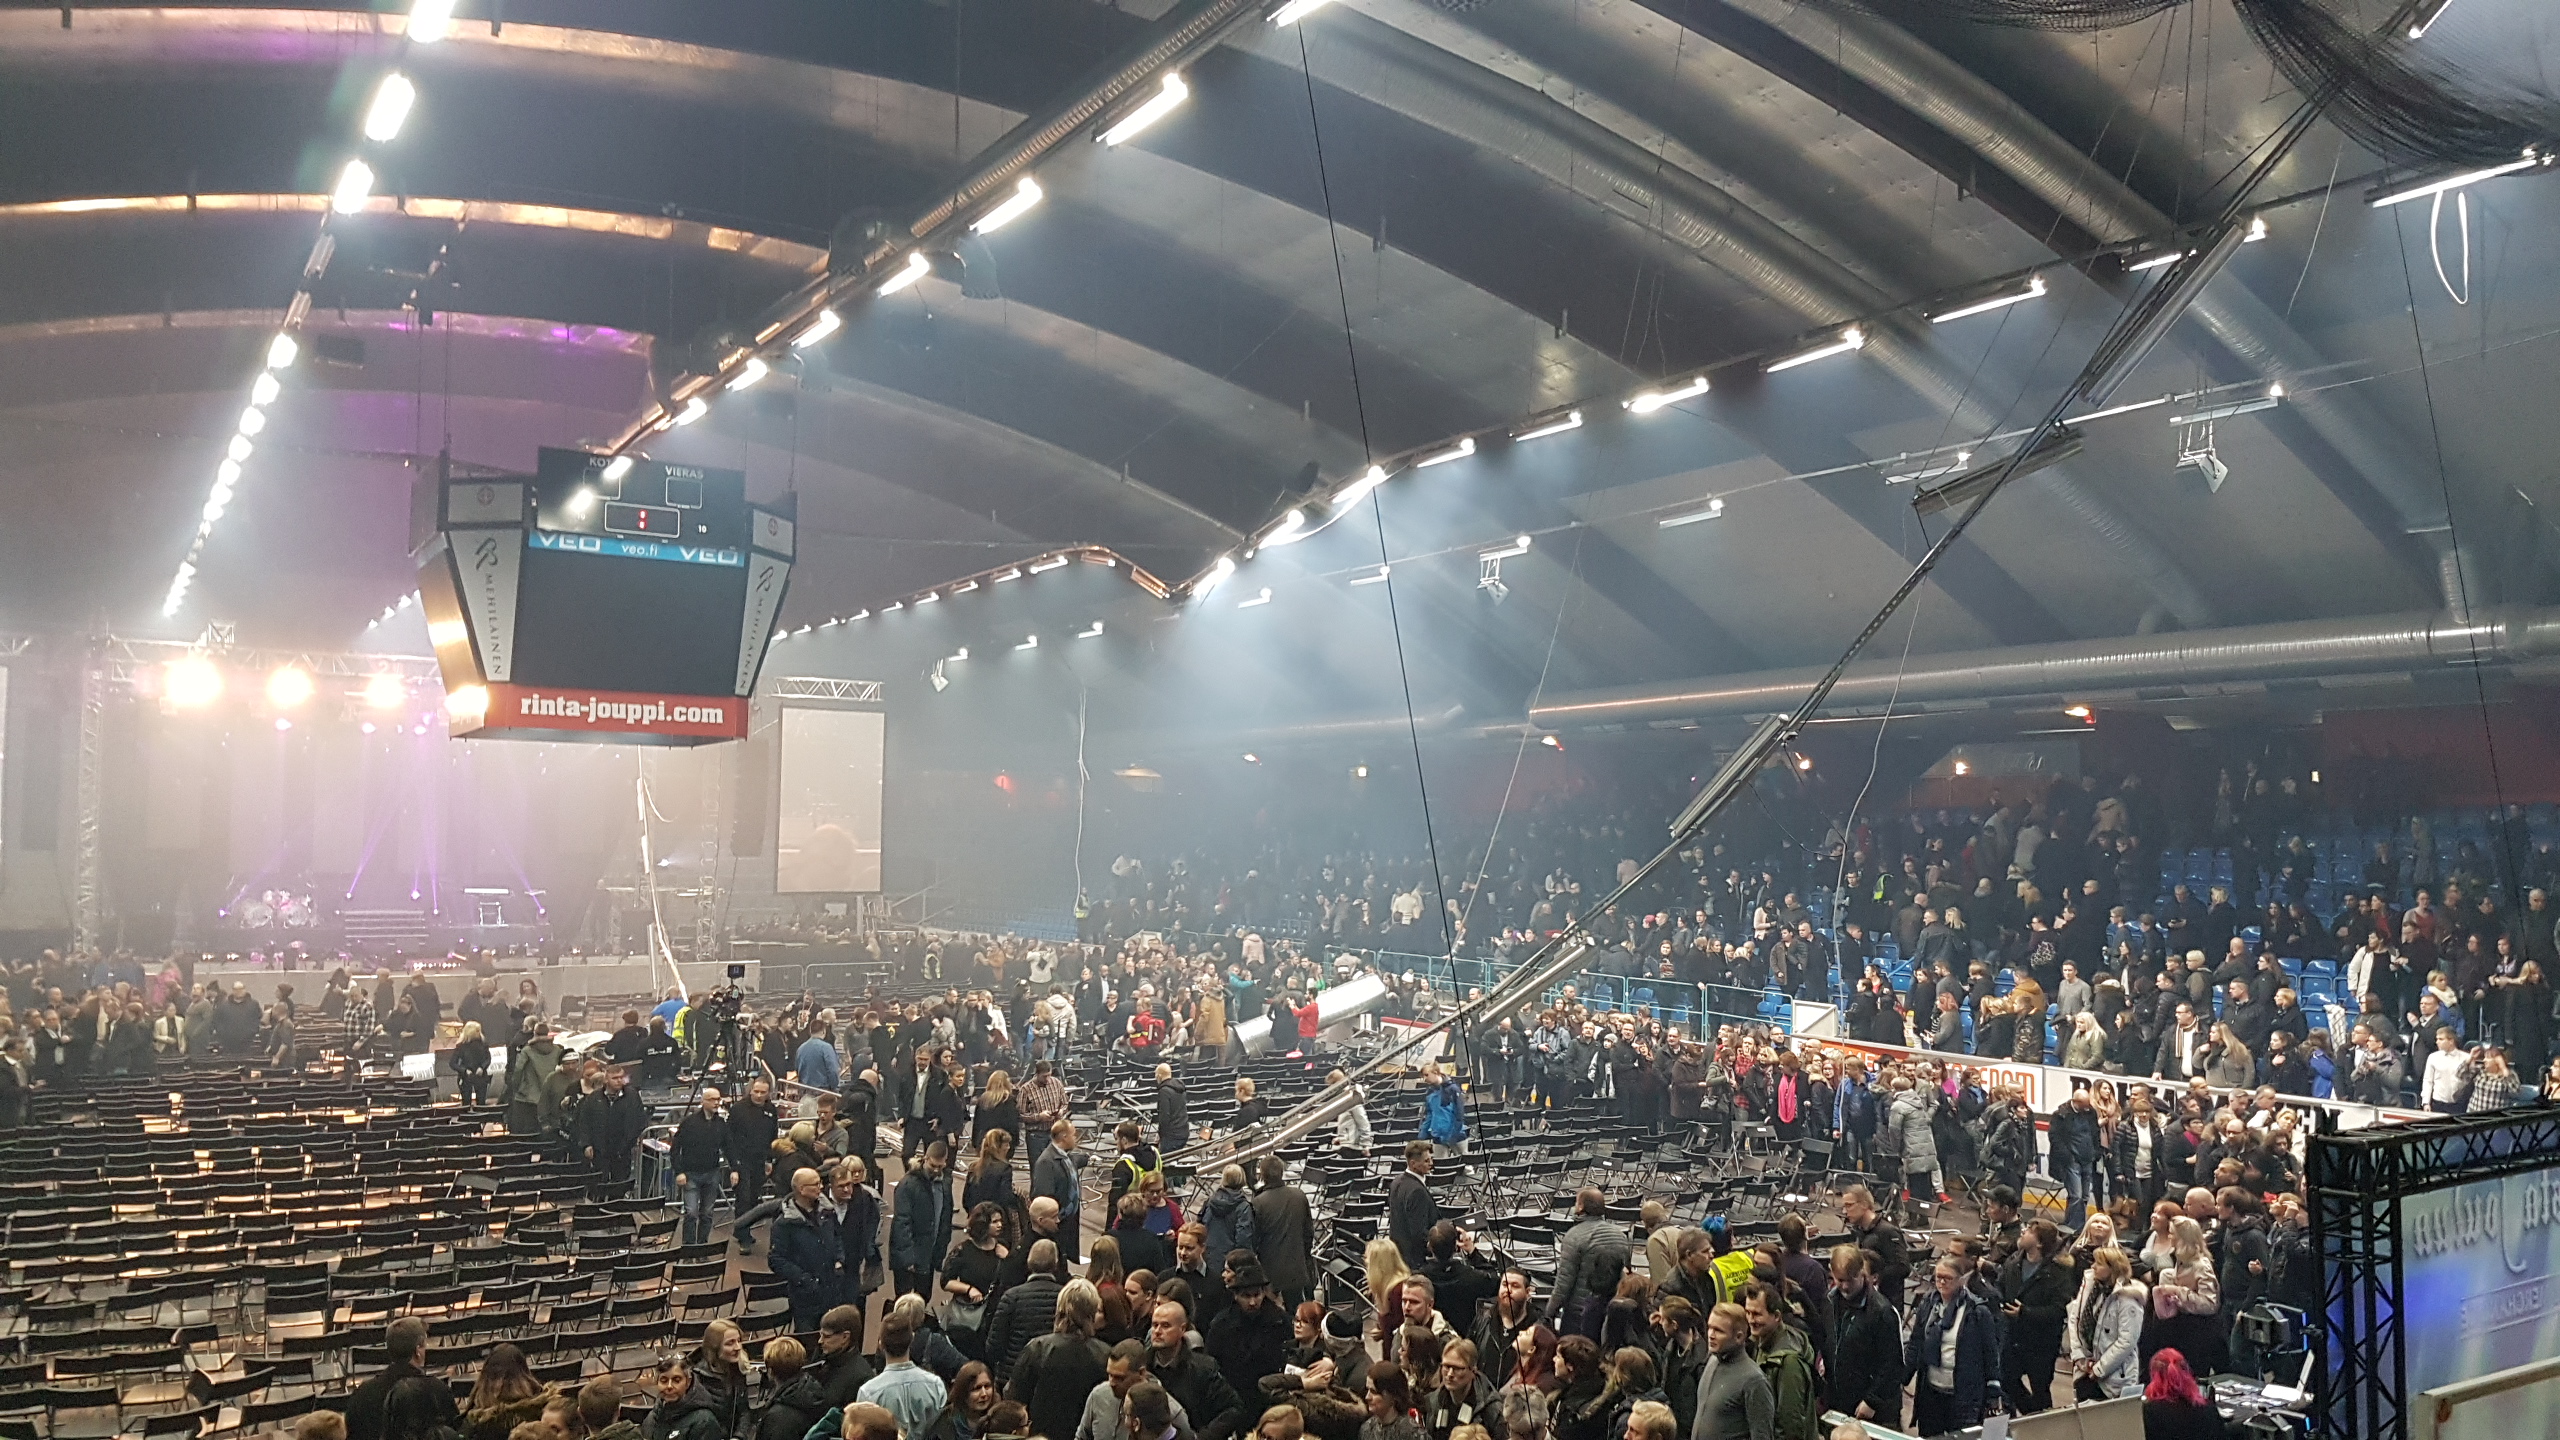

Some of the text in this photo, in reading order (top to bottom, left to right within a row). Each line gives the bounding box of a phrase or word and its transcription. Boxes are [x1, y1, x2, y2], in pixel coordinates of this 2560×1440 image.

[665, 465, 704, 480] VIERAS
[538, 532, 739, 565] VEO veo.fi VEO
[520, 693, 725, 725] rinta-jouppi.com
